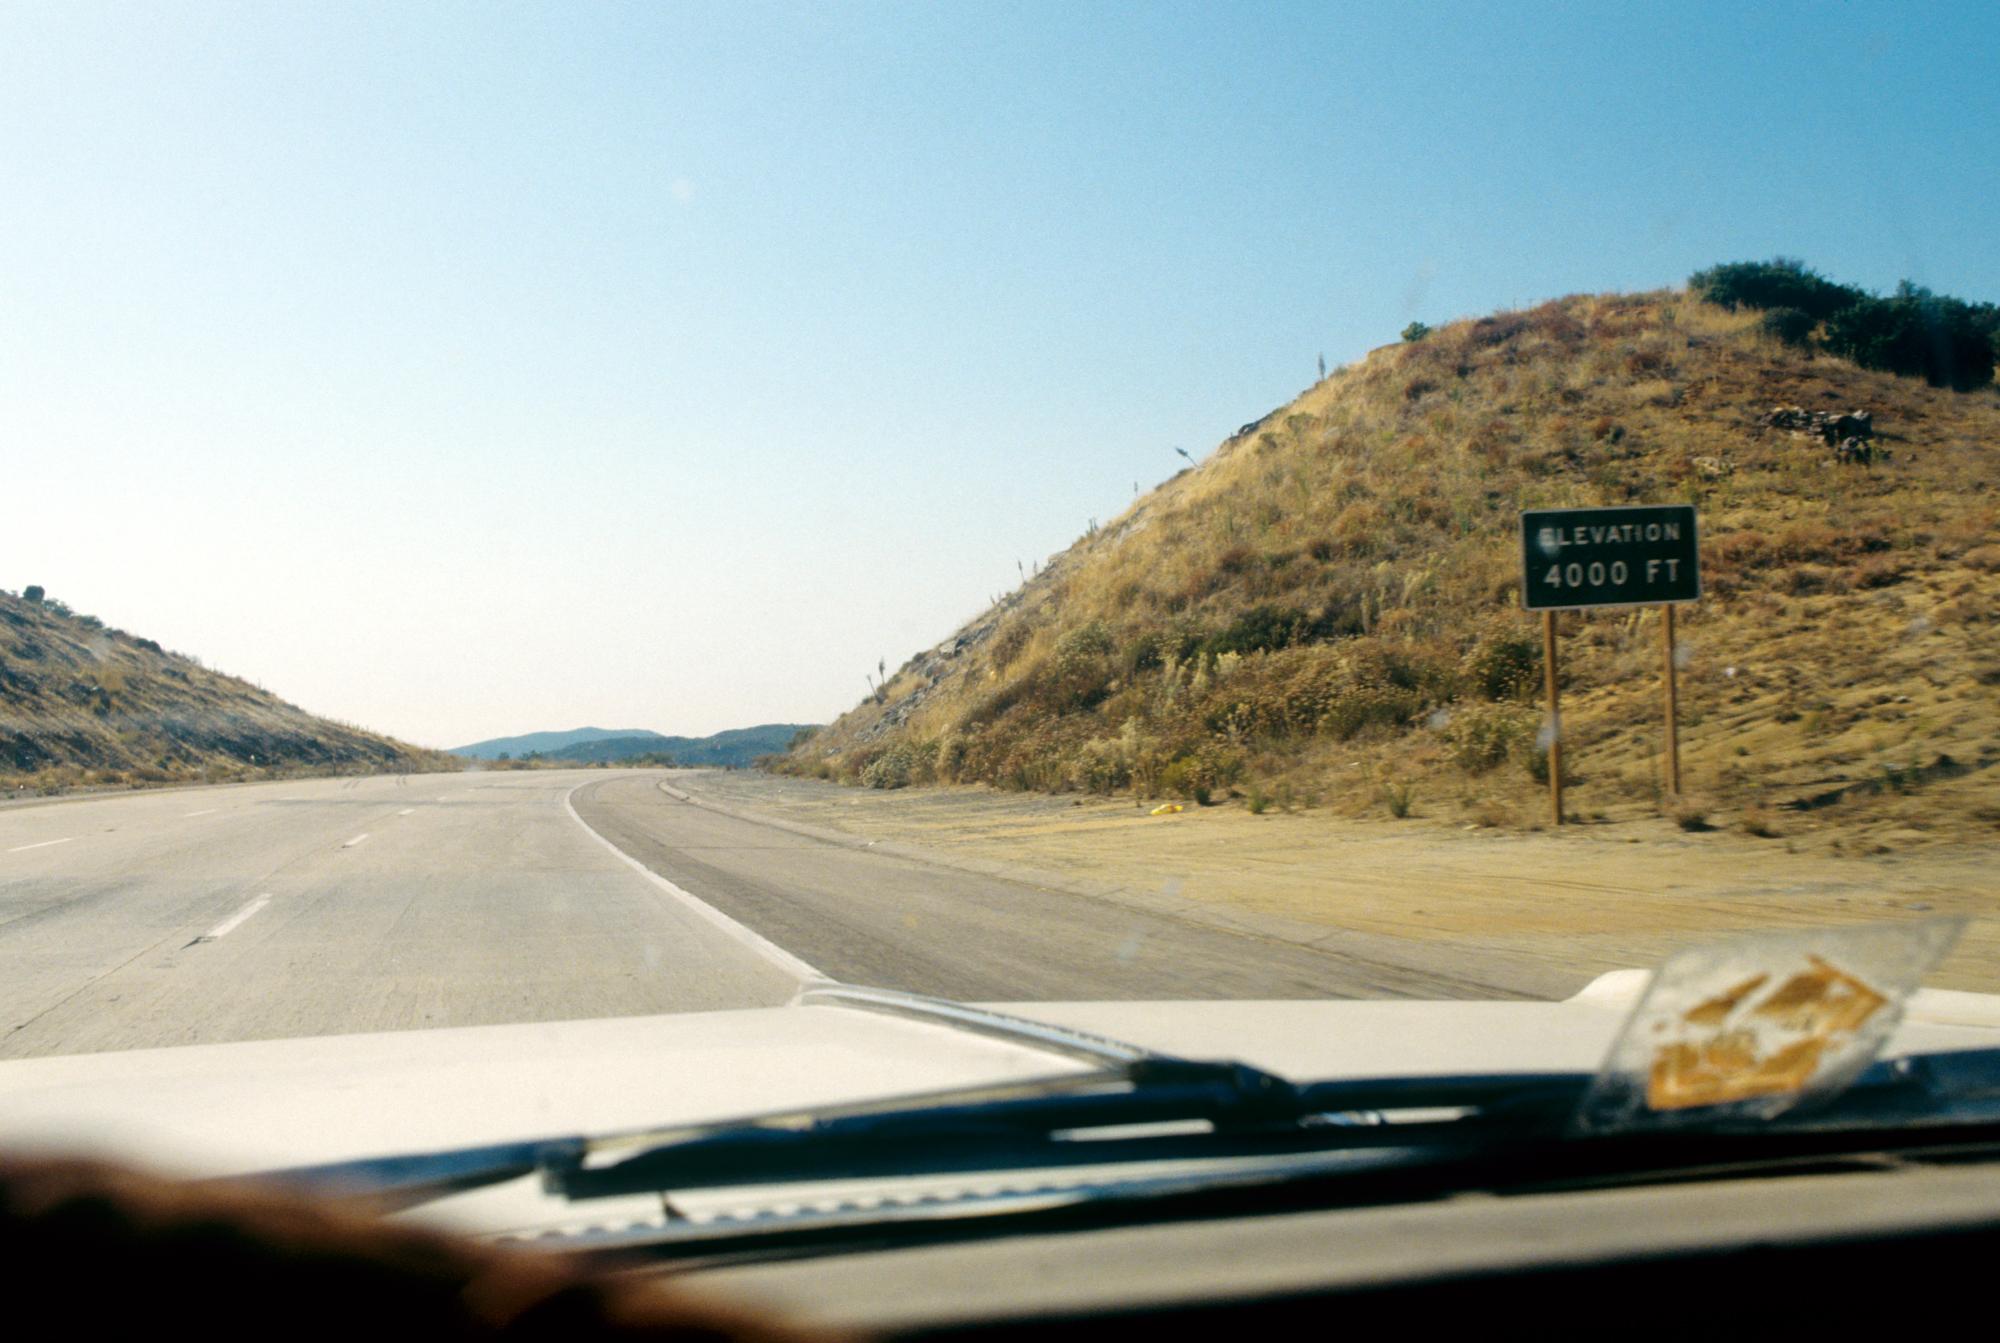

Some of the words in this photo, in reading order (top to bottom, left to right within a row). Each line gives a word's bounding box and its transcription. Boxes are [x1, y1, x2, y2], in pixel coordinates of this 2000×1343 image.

[1539, 523, 1680, 547] ELEVATION
[1543, 561, 1628, 588] 4000
[1647, 558, 1681, 584] FT
